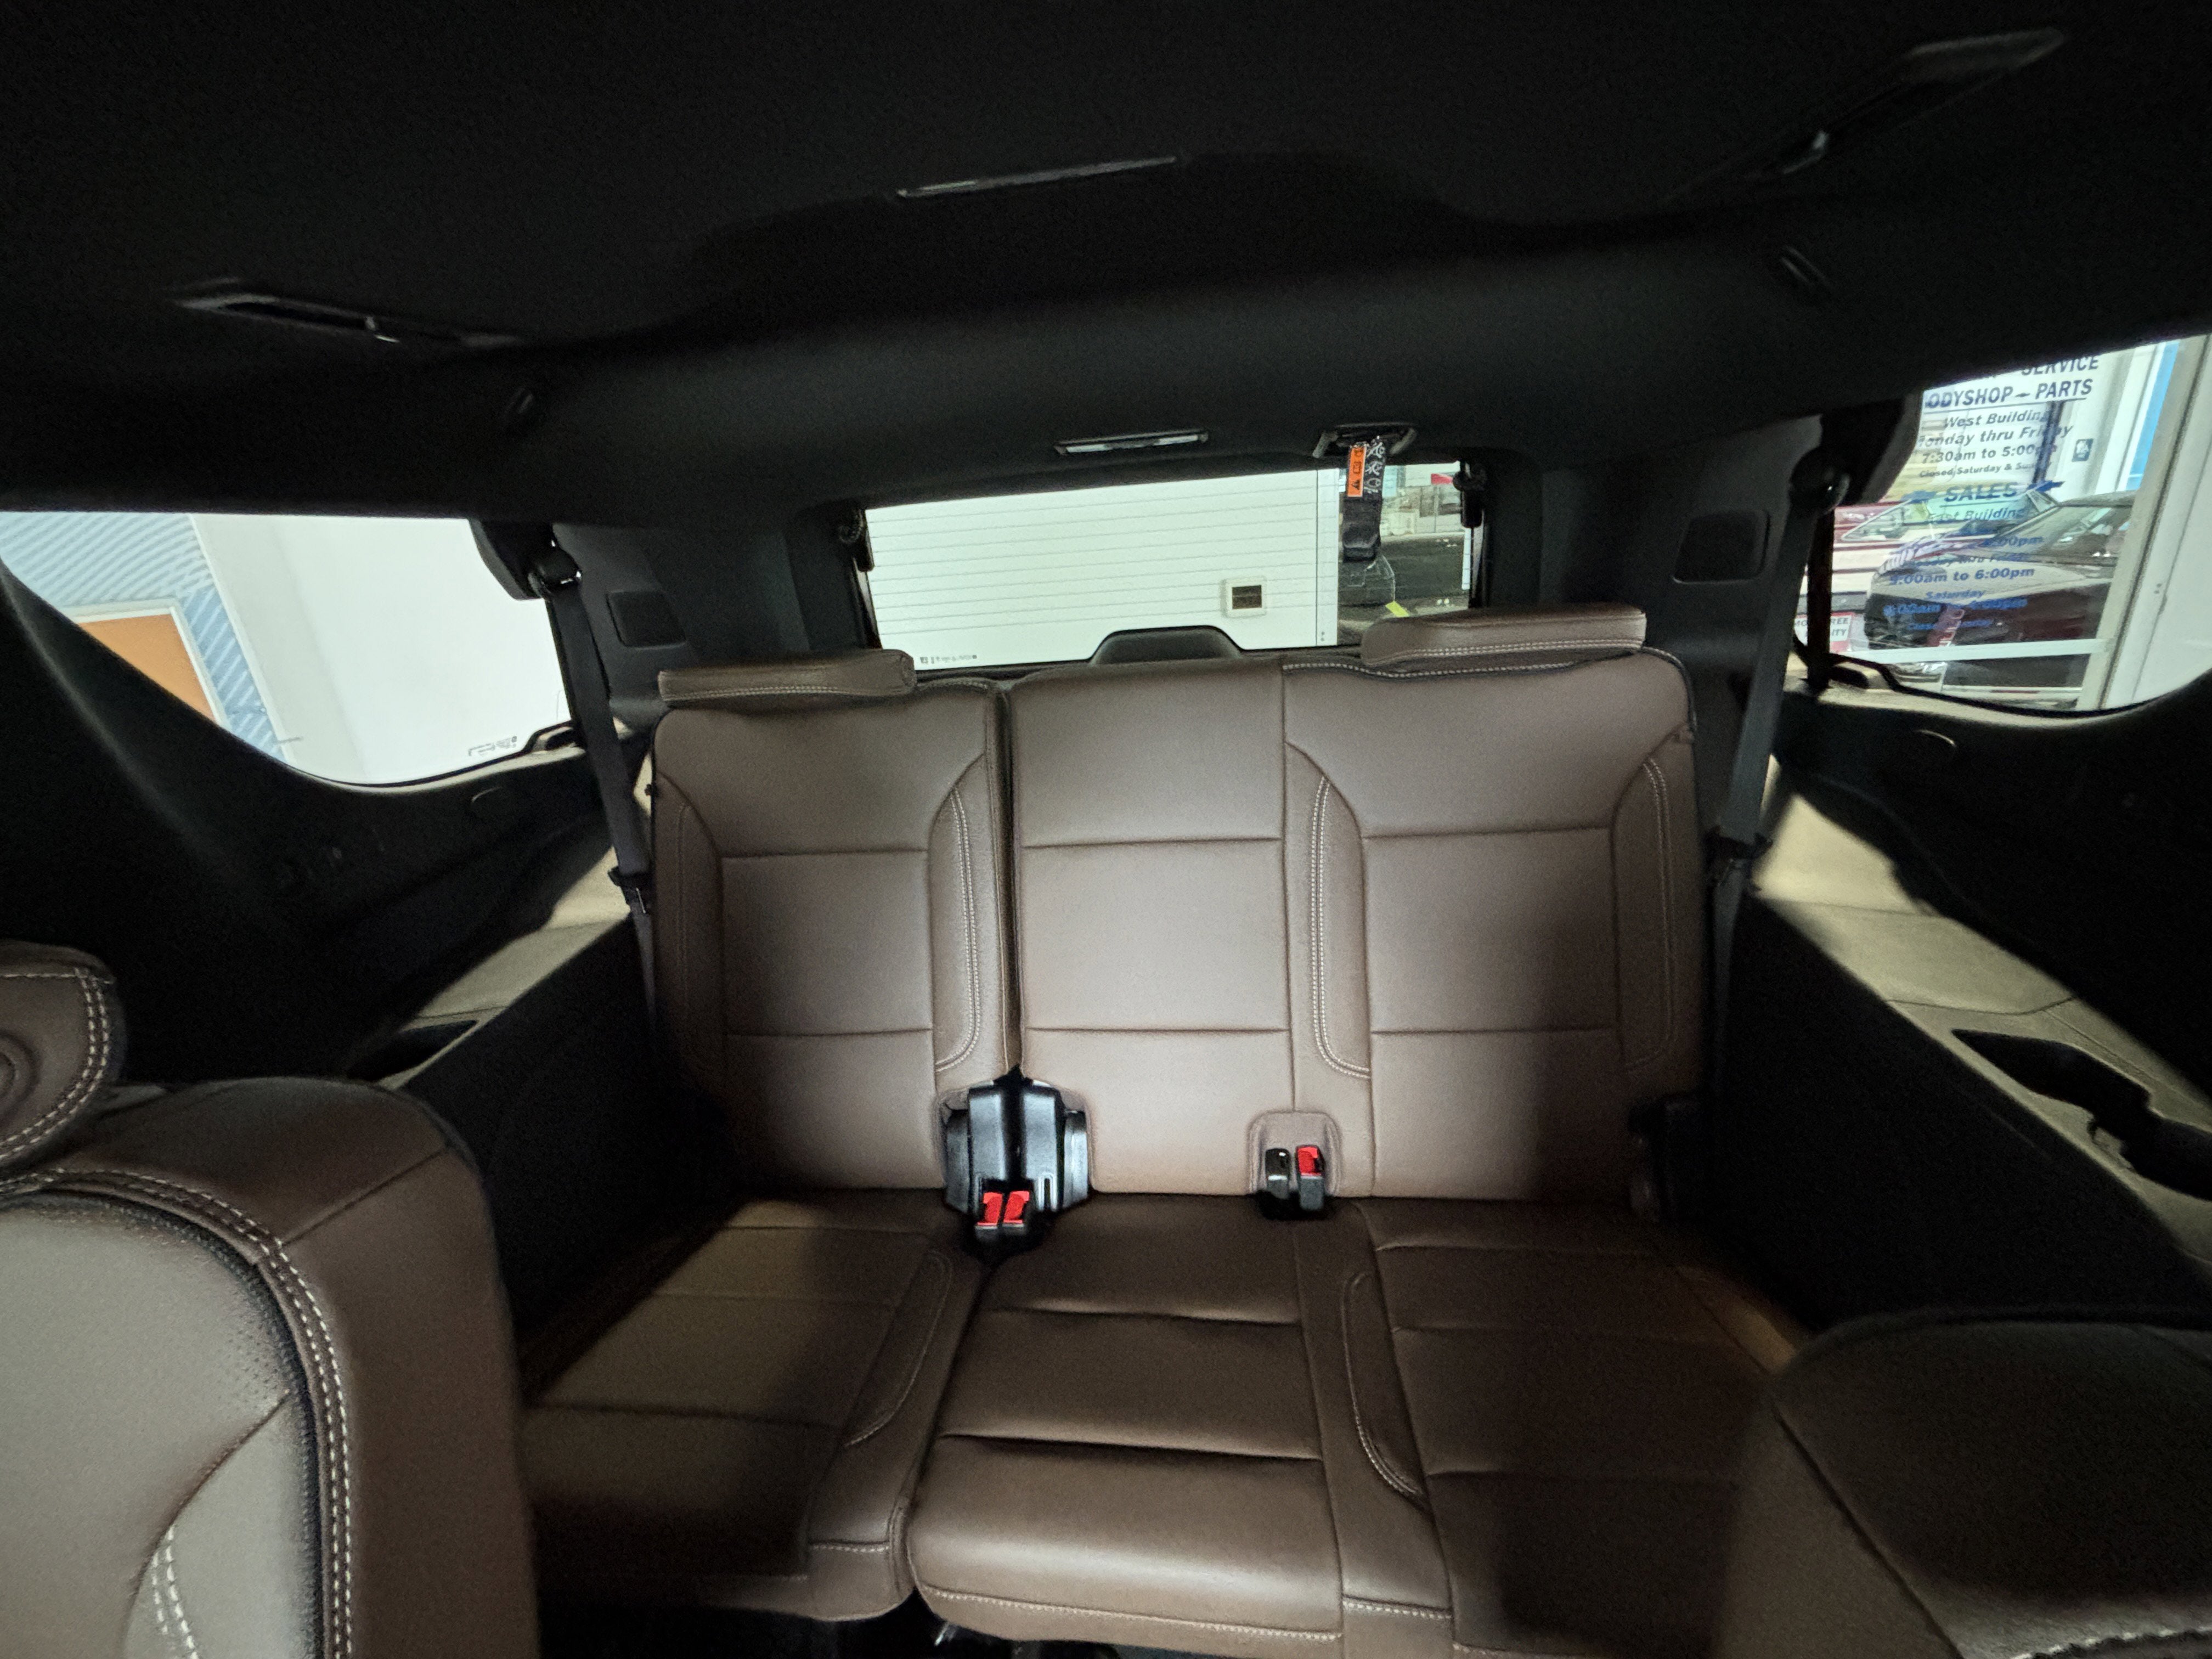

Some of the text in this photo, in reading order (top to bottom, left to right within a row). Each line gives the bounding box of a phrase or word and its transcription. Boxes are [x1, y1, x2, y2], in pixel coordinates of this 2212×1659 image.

[1925, 386, 2014, 409] ODYSHOP
[2035, 379, 2094, 399] PARTS
[1943, 414, 1982, 429] West
[1980, 430, 2015, 443] thru
[2018, 425, 2074, 439] Friy
[1922, 443, 2057, 464] 7:30am to 5:00
[1956, 465, 2002, 475] Saturday
[1944, 482, 2018, 503] SALES
[1953, 571, 1970, 582] to
[1974, 567, 2036, 580] 6:00pm
